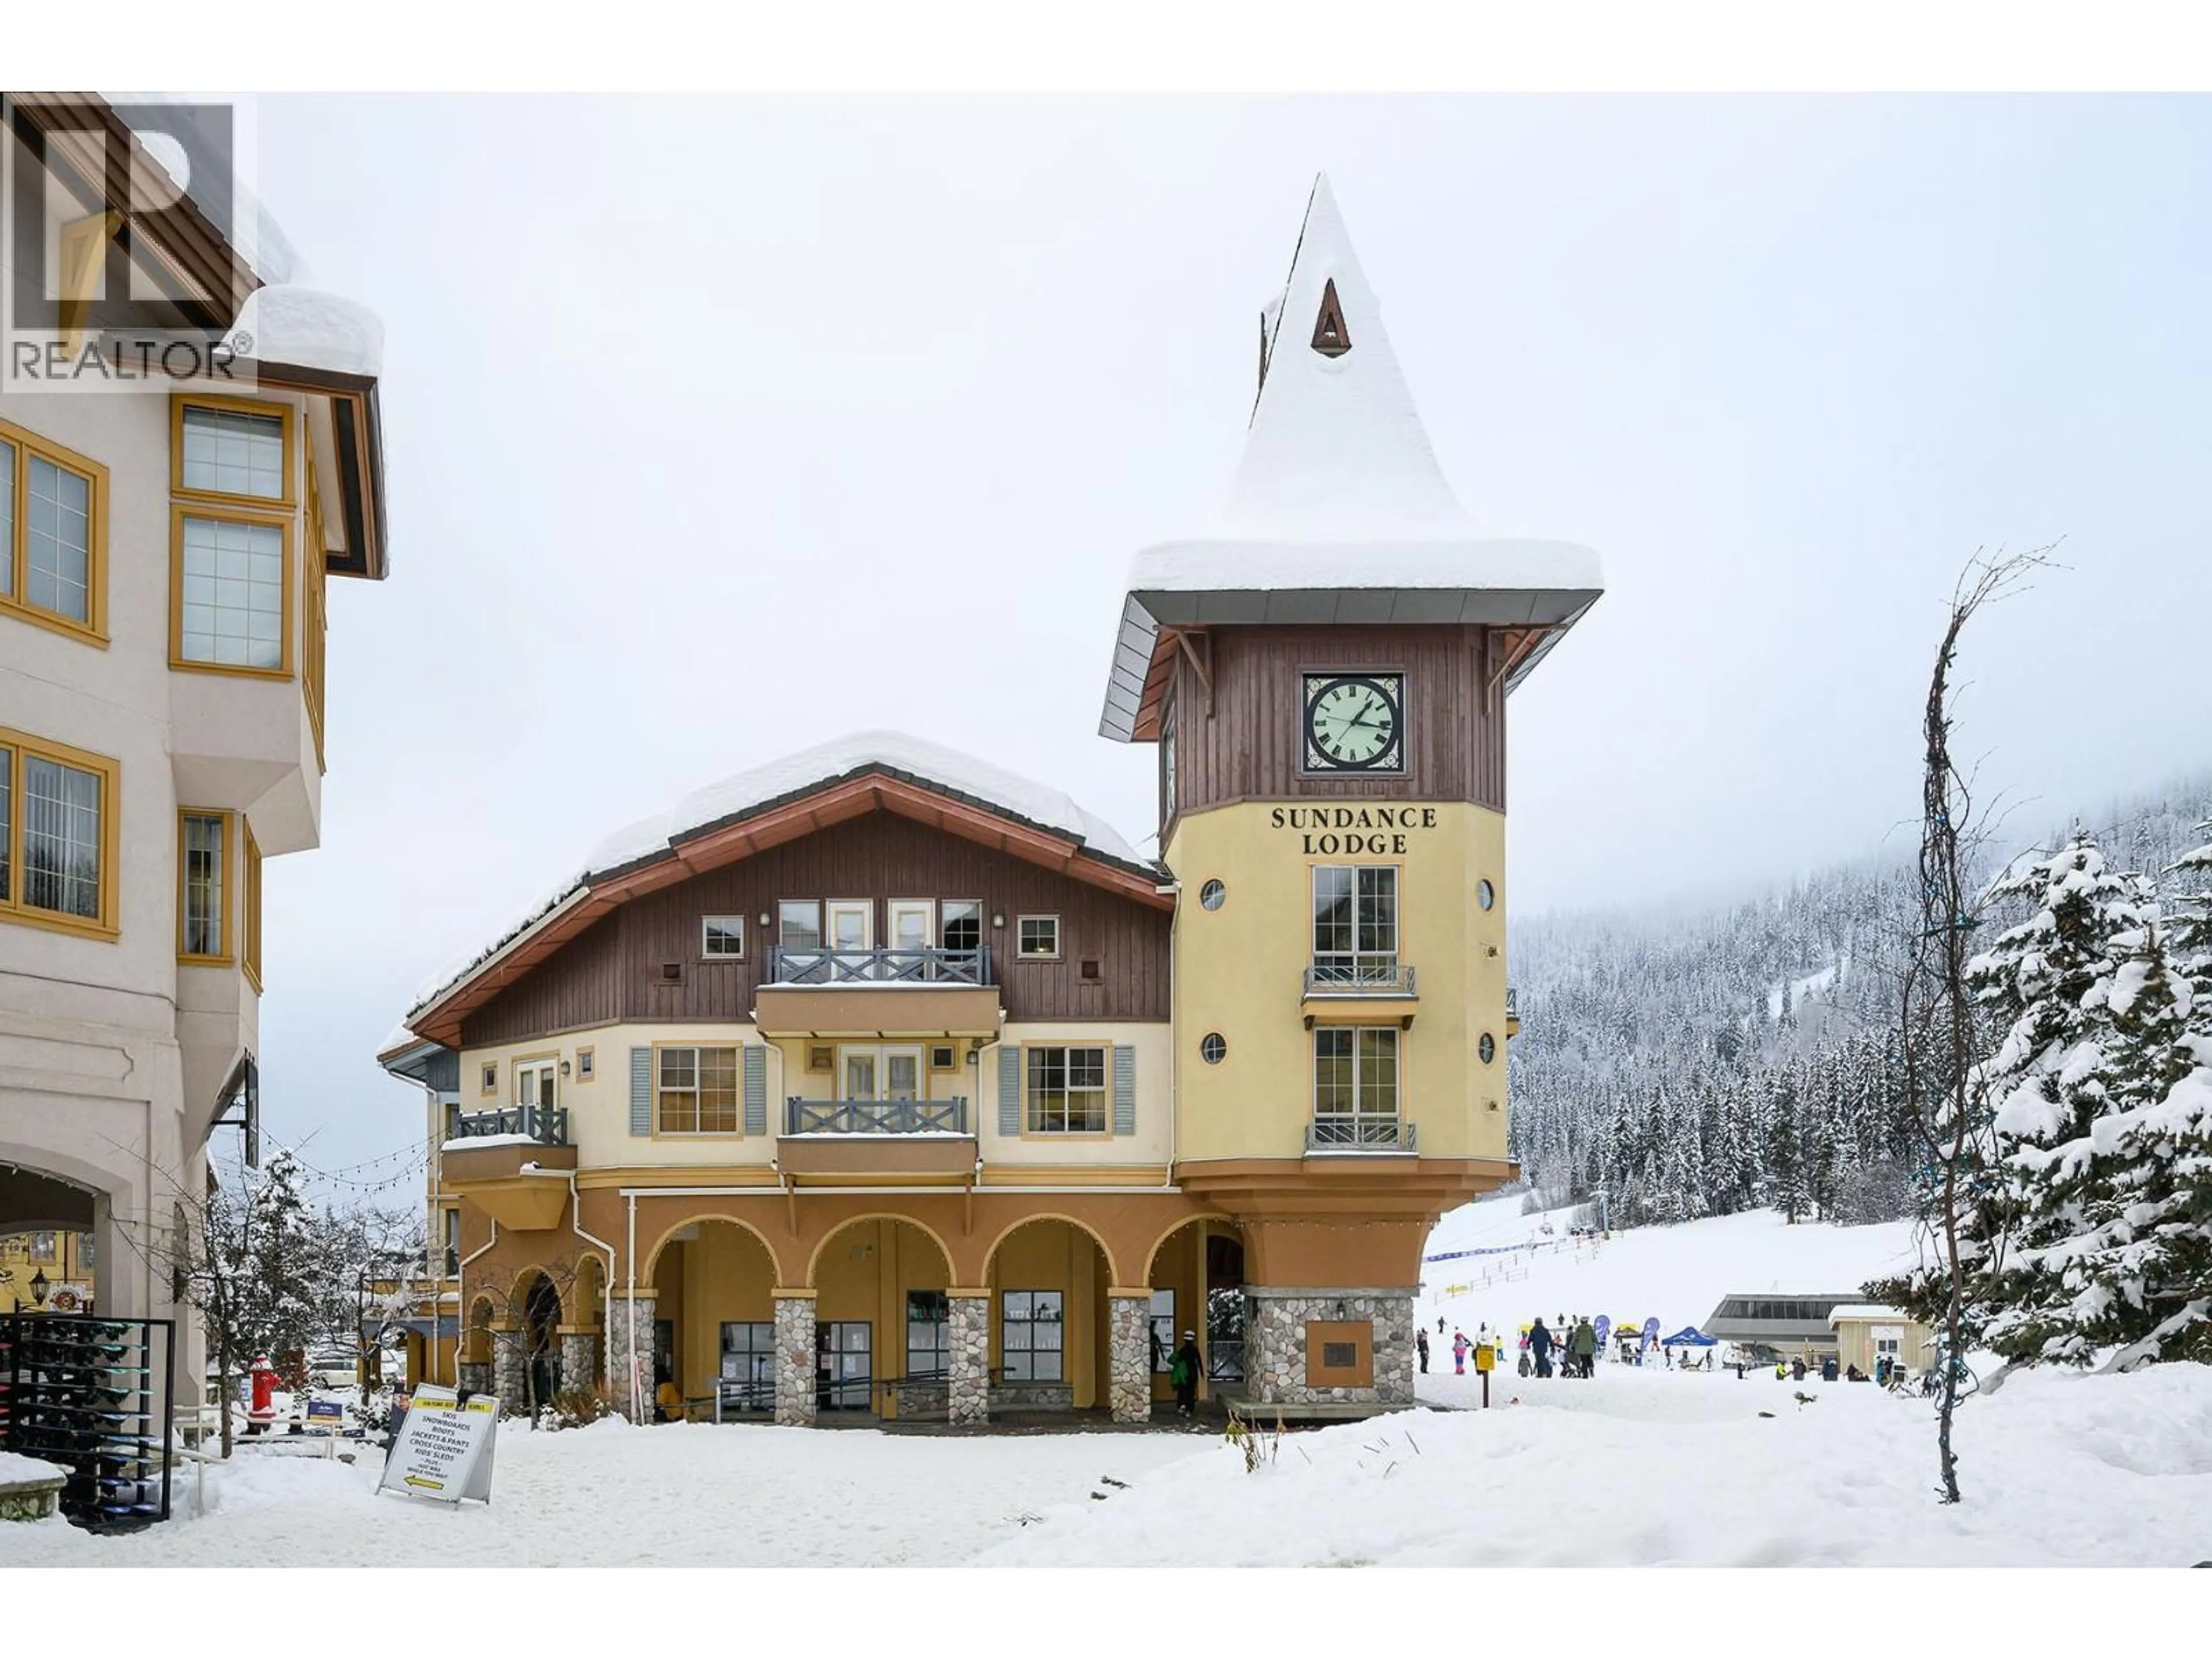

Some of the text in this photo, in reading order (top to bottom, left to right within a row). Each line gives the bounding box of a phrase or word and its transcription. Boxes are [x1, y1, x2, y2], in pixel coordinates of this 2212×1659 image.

[1271, 808, 1437, 828] SUNDANCE
[1303, 834, 1407, 854] LODGE
[442, 1411, 456, 1419] SKIS
[422, 1416, 471, 1431] SNOWBOARDS
[431, 1426, 454, 1435] BOOTS
[409, 1438, 464, 1455] CROSS COUNTRY
[411, 1430, 440, 1441] JACKETS
[448, 1438, 469, 1448] PANTS
[433, 1452, 454, 1461] SLEDS
